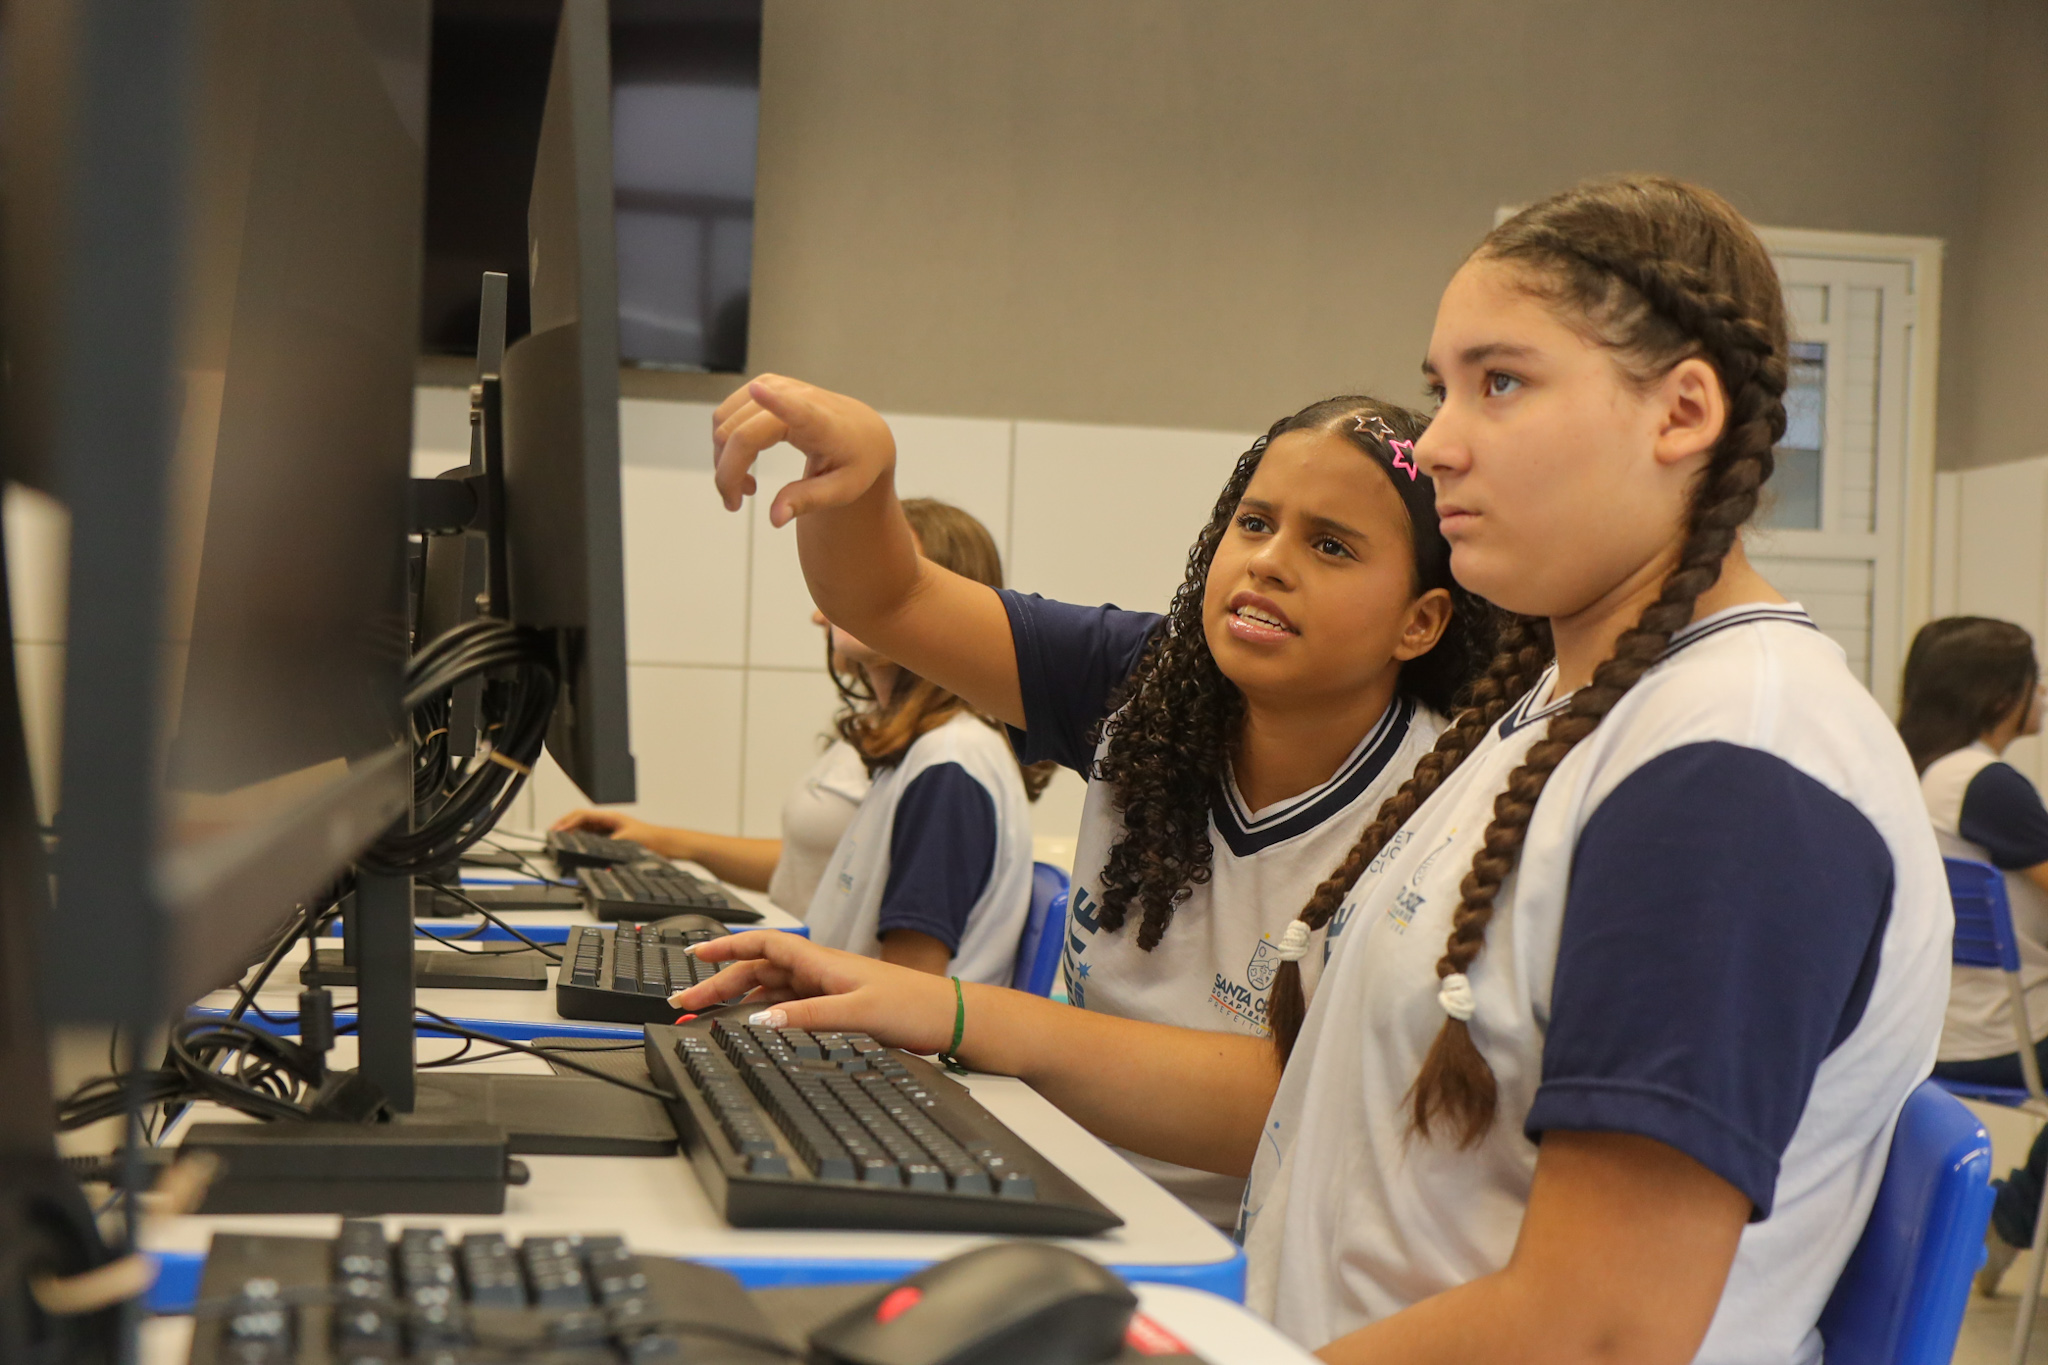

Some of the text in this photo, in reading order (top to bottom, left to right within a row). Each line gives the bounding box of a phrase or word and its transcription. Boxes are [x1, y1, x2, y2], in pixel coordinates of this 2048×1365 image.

[1215, 973, 1252, 1007] SANTA
[1208, 997, 1273, 1039] PREFEITUR
[1223, 996, 1267, 1024] CAPIBAR
